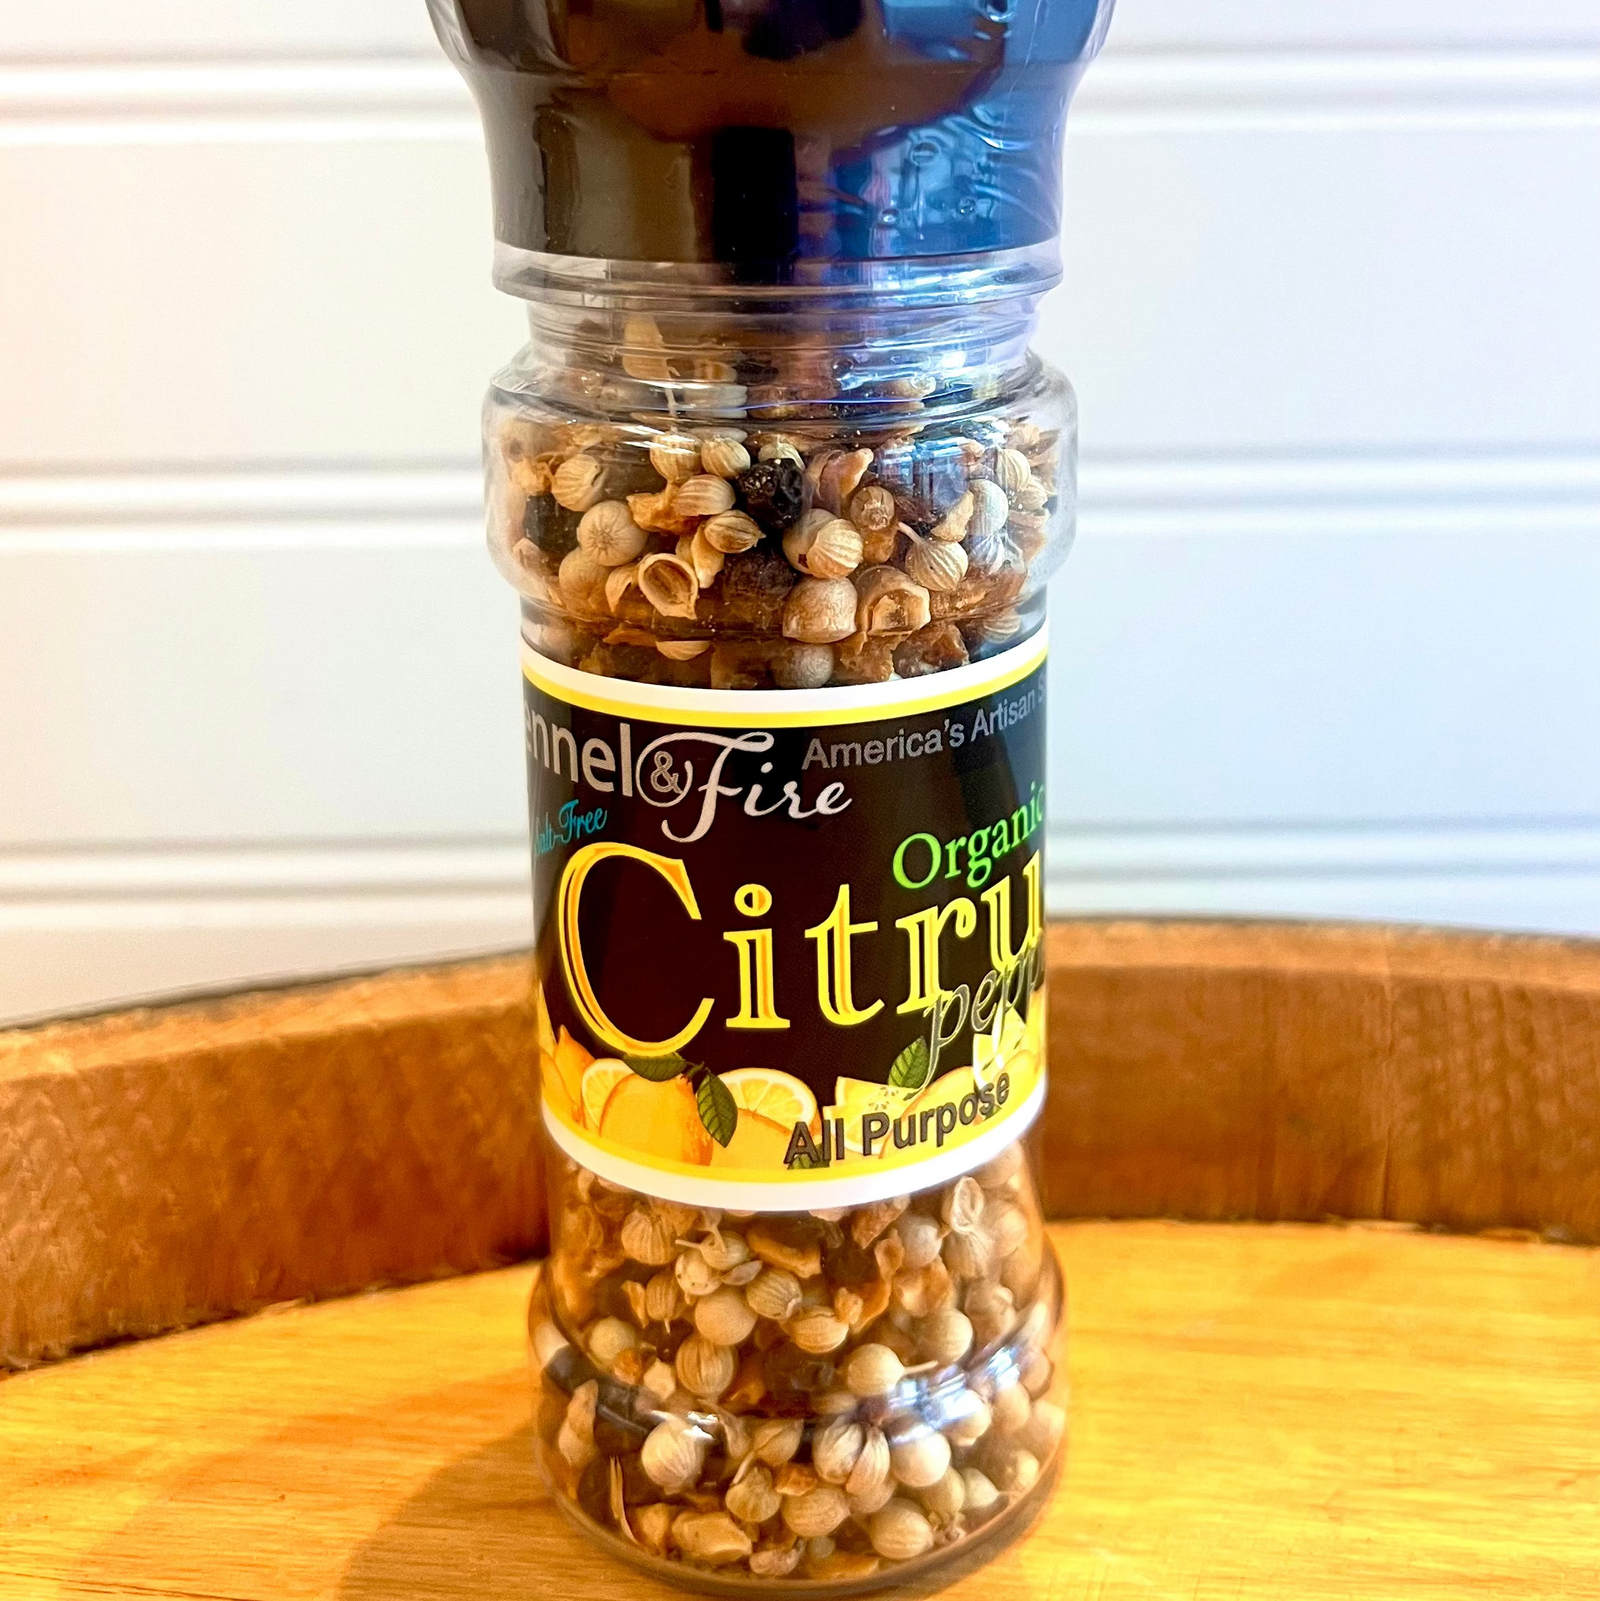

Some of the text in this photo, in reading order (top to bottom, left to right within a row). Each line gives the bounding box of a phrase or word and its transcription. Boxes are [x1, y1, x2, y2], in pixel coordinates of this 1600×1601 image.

[801, 718, 965, 770] America's
[971, 689, 1035, 742] Artisan
[636, 731, 852, 843] Fire
[892, 780, 1044, 889] Organic
[558, 841, 1043, 1057] Citru
[783, 1072, 1010, 1164] All Purpose
